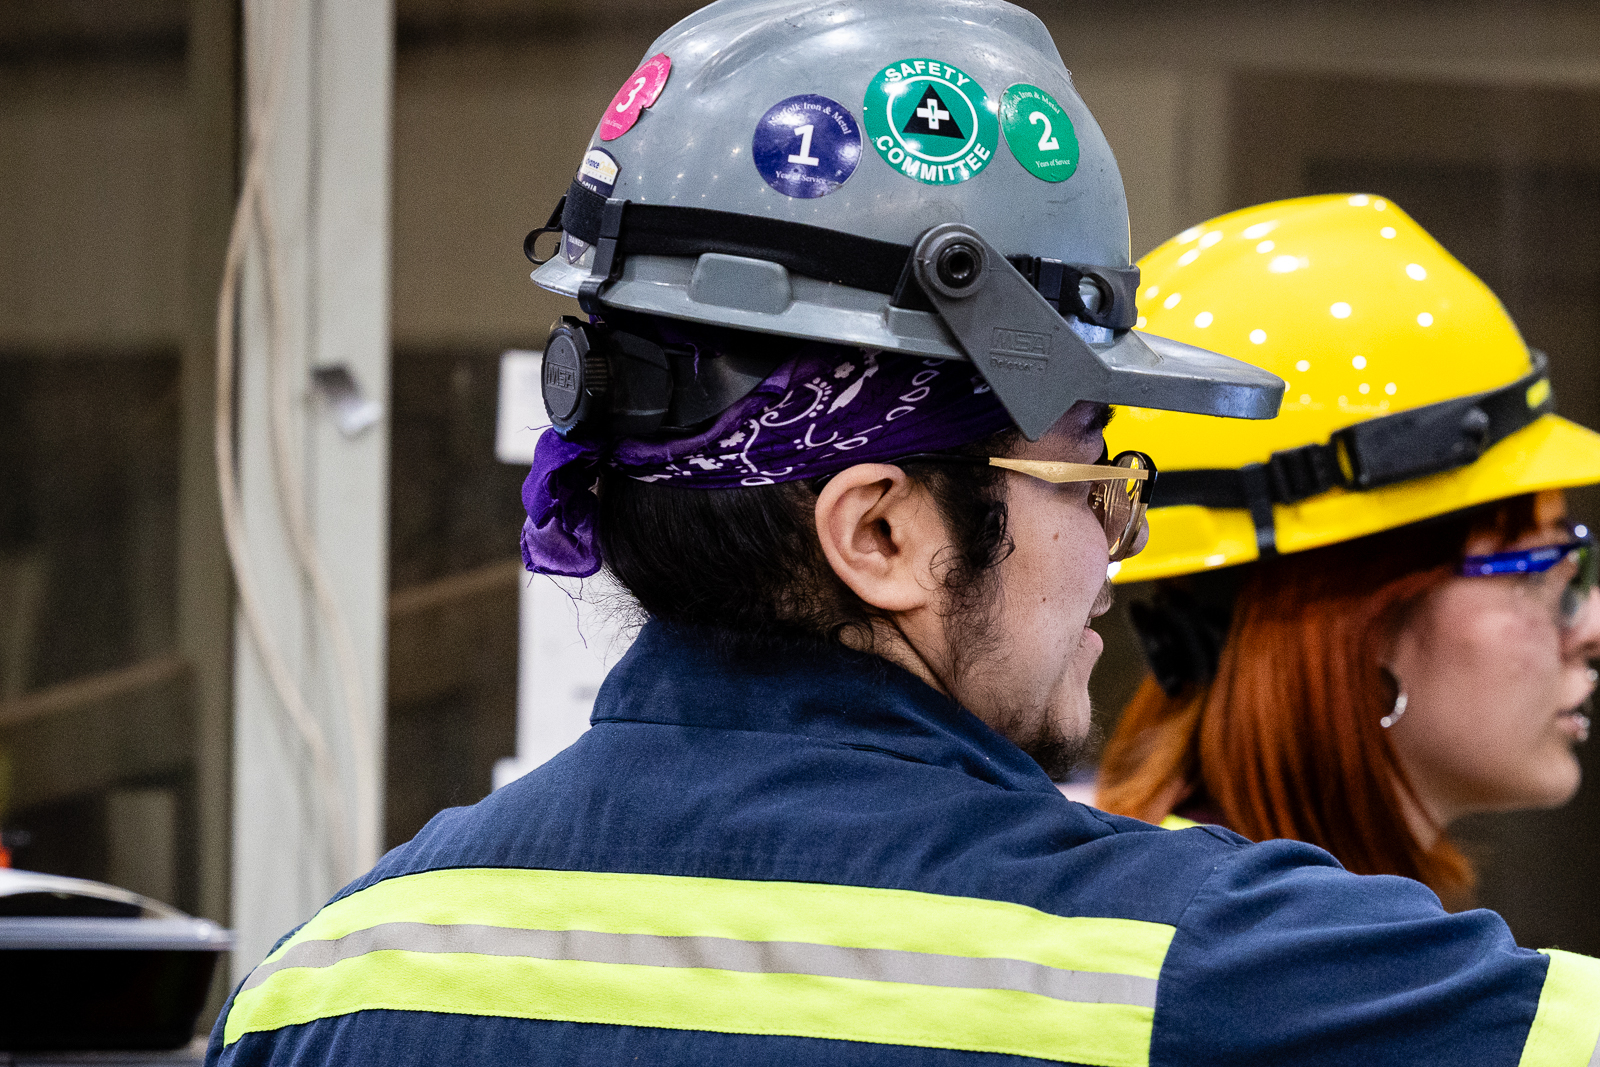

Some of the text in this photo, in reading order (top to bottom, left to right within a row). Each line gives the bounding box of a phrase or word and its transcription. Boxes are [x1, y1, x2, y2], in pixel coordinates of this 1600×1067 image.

[885, 61, 970, 86] SAFETY
[615, 76, 646, 113] 3
[767, 102, 852, 135] Norfolk Iron & Metal
[1028, 111, 1060, 151] 2
[788, 124, 819, 166] 1
[877, 135, 991, 182] COMMITTEE
[993, 328, 1047, 354] MSA
[547, 363, 575, 390] MSA
